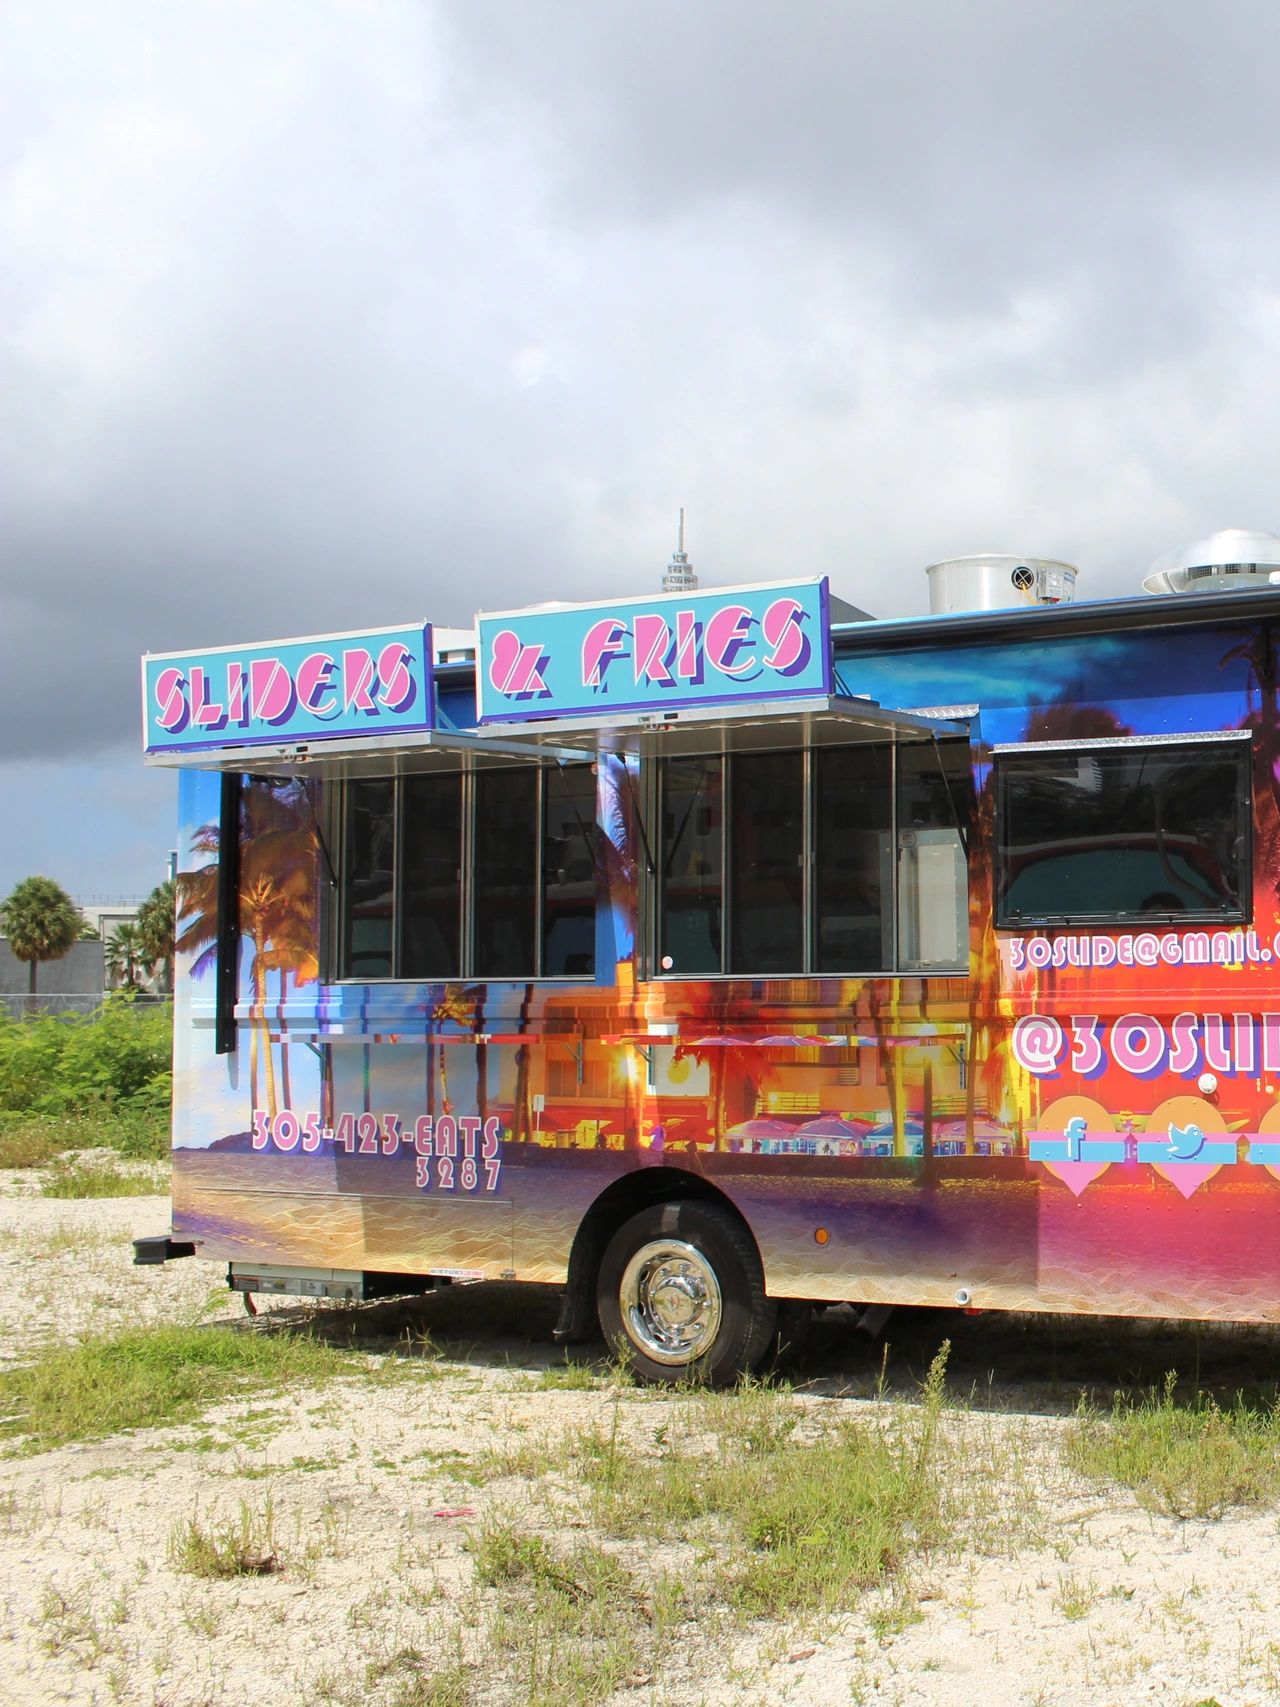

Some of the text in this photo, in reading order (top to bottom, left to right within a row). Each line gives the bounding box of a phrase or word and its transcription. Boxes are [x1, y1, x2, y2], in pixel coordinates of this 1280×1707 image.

[155, 642, 413, 731] SLIDERS
[489, 597, 807, 697] & FRIES
[252, 1109, 500, 1159] 305-423-EATS
